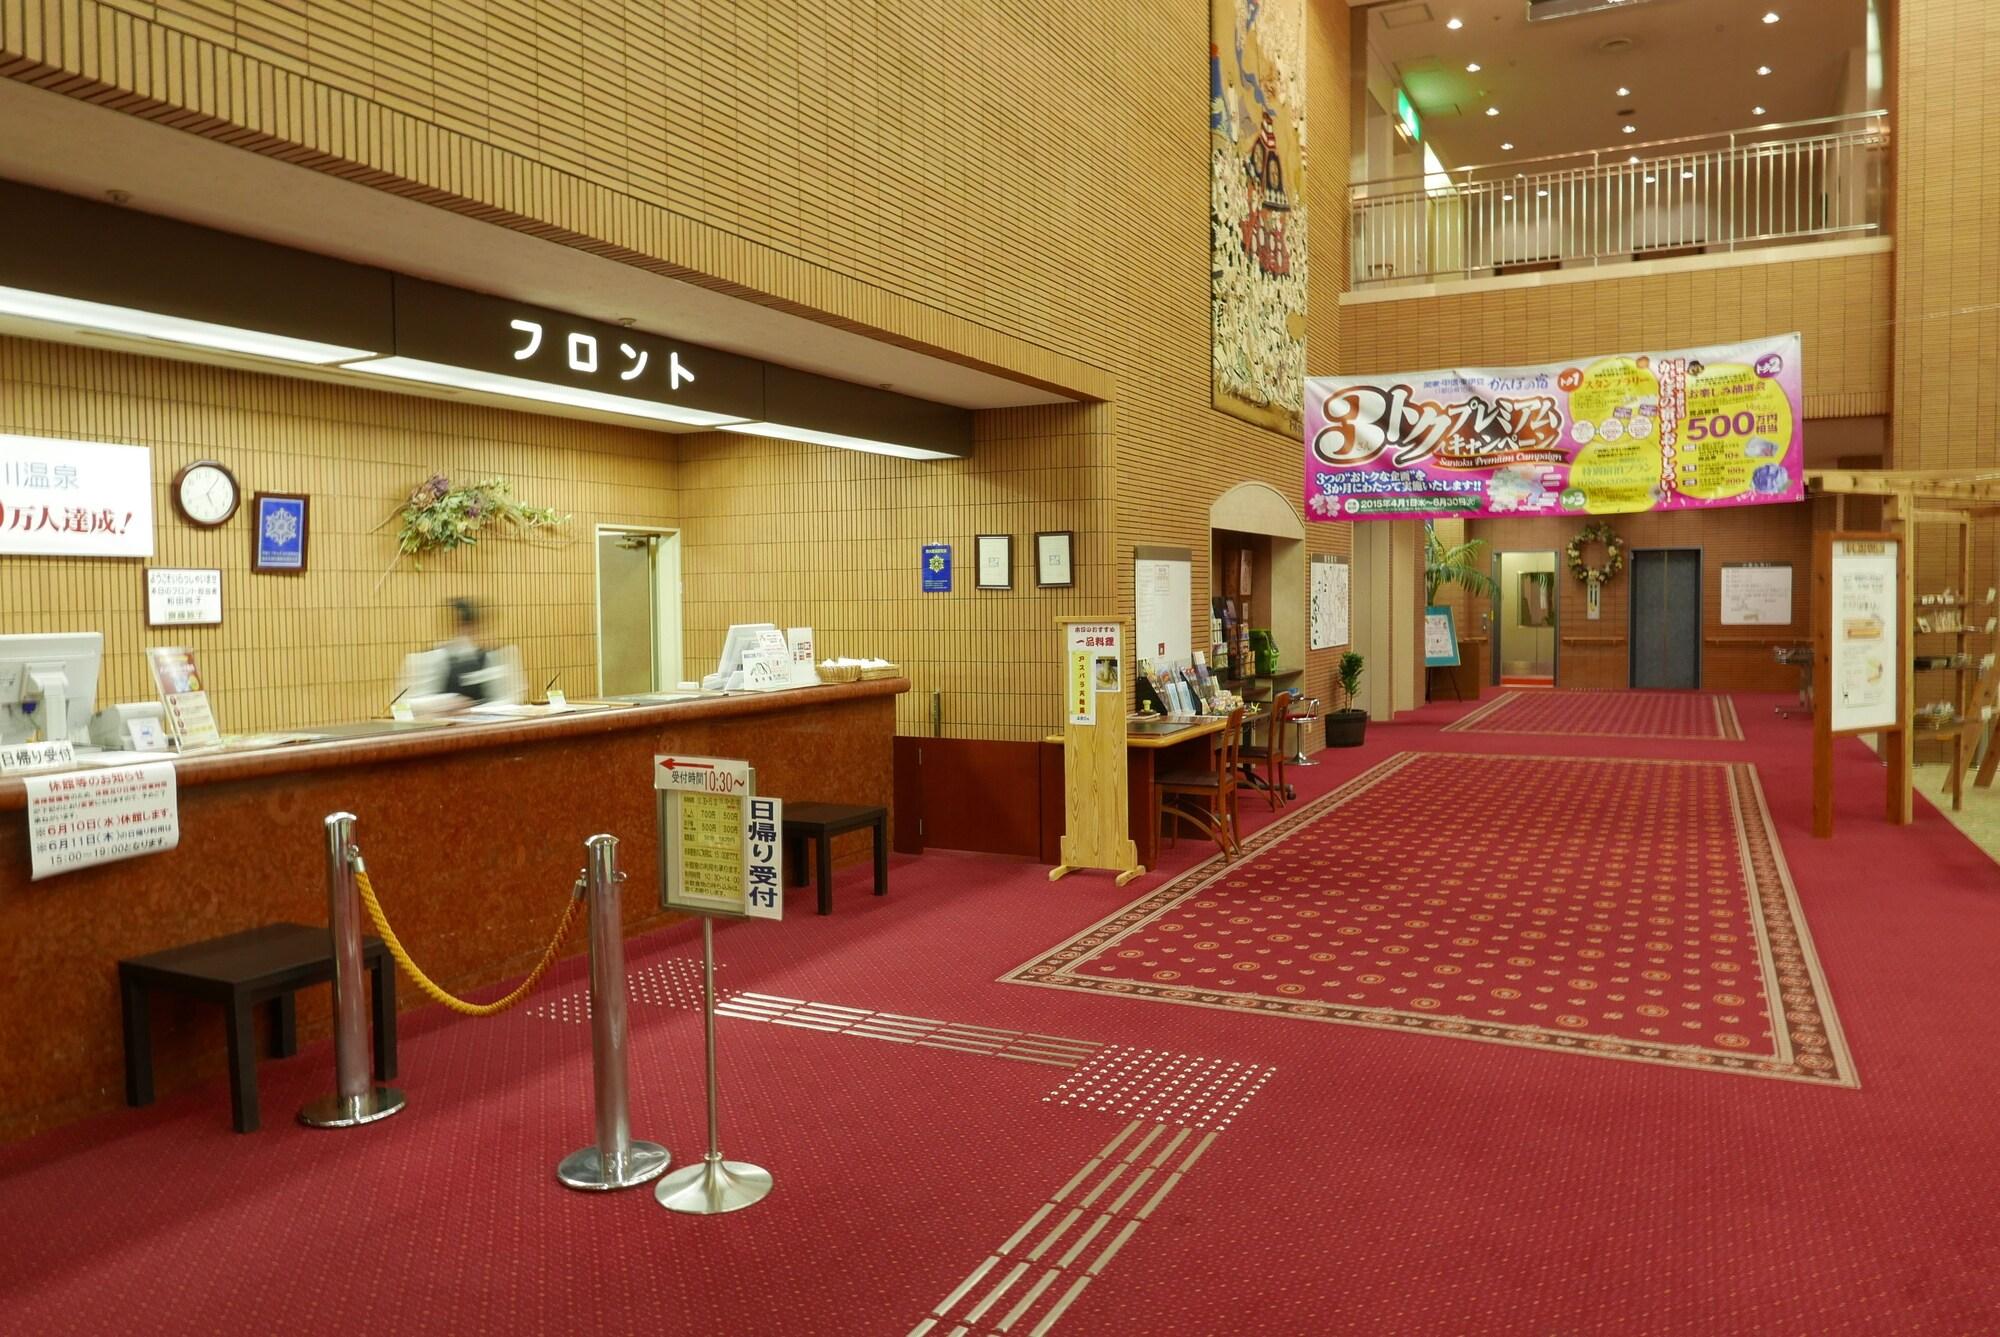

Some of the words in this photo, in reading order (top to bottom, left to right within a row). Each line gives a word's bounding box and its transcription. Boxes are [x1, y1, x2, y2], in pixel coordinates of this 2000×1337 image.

[511, 319, 695, 390] フロント
[1687, 411, 1755, 441] 500
[1440, 457, 1473, 468] Santoku
[1475, 455, 1514, 466] Premium
[1516, 453, 1562, 463] Campaign
[1076, 636, 1115, 647] 一品料理
[1, 748, 72, 767] 日帰り受付
[748, 800, 778, 908] 日帰り受付
